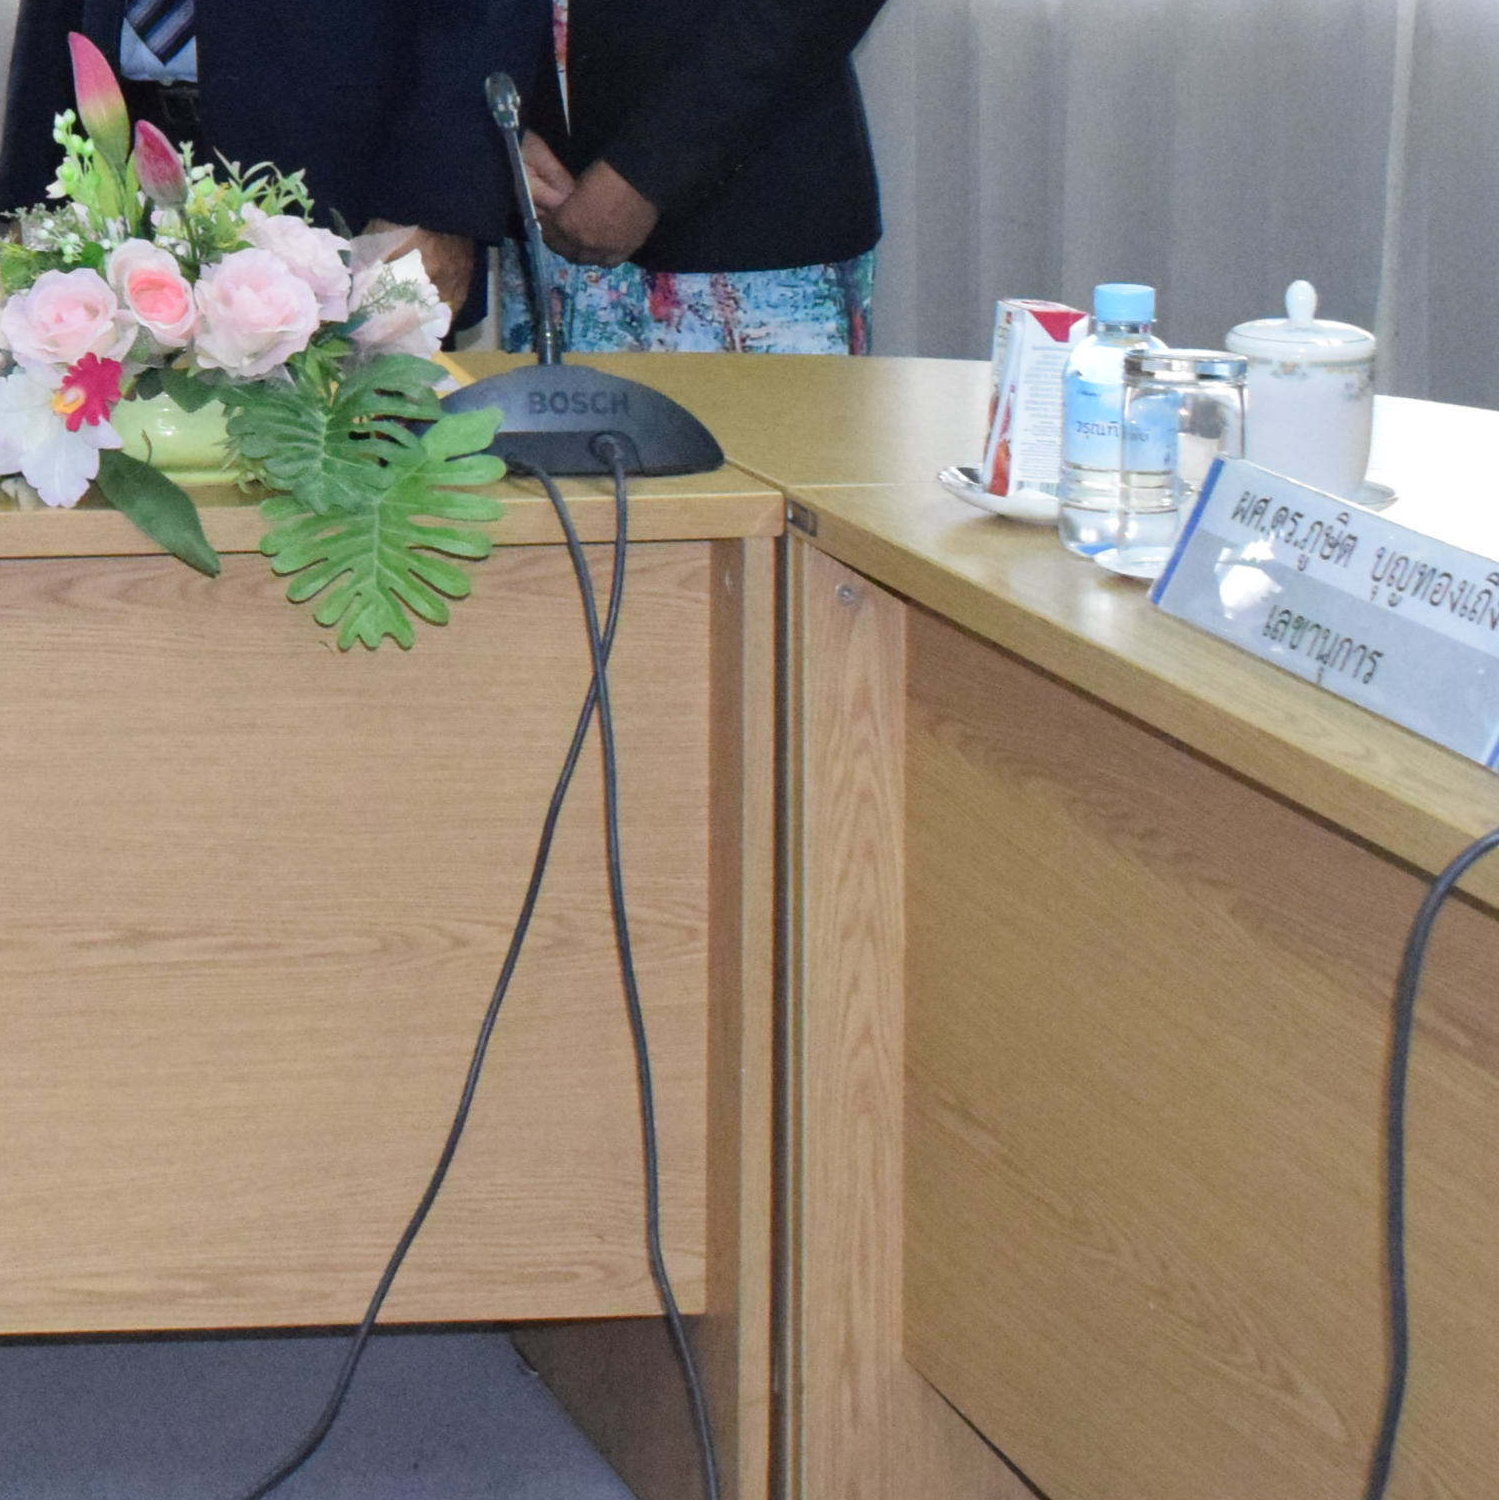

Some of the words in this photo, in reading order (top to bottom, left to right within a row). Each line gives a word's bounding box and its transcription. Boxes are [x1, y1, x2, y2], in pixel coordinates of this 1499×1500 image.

[528, 389, 630, 416] BOSCH
[1262, 604, 1385, 686] เลขานุการ
